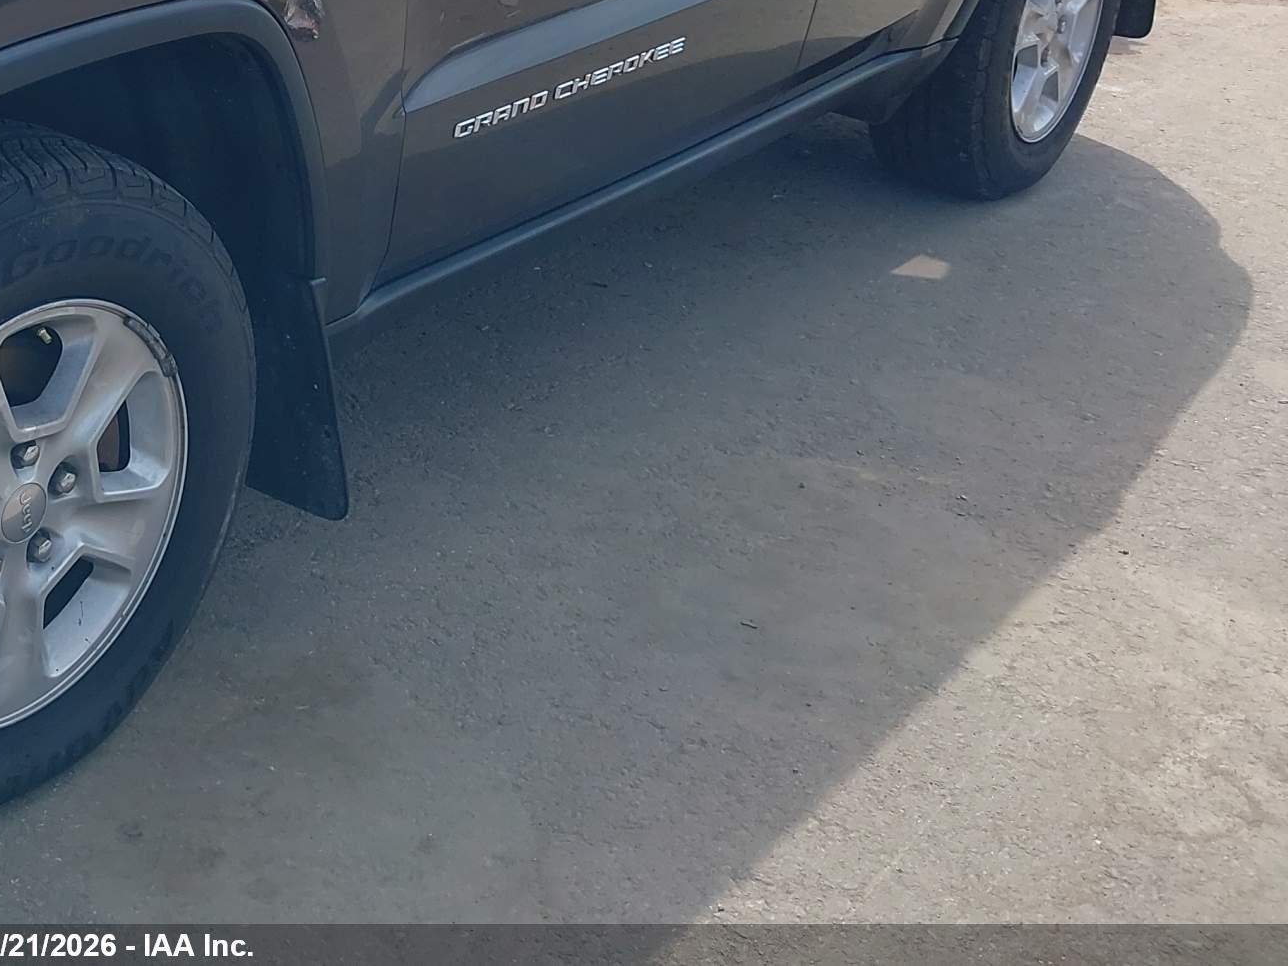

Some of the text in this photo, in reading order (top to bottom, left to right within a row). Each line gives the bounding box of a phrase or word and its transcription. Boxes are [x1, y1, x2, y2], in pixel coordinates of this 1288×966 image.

[453, 36, 687, 139] GRAND CHEROKEE
[17, 492, 33, 533] Jeep
